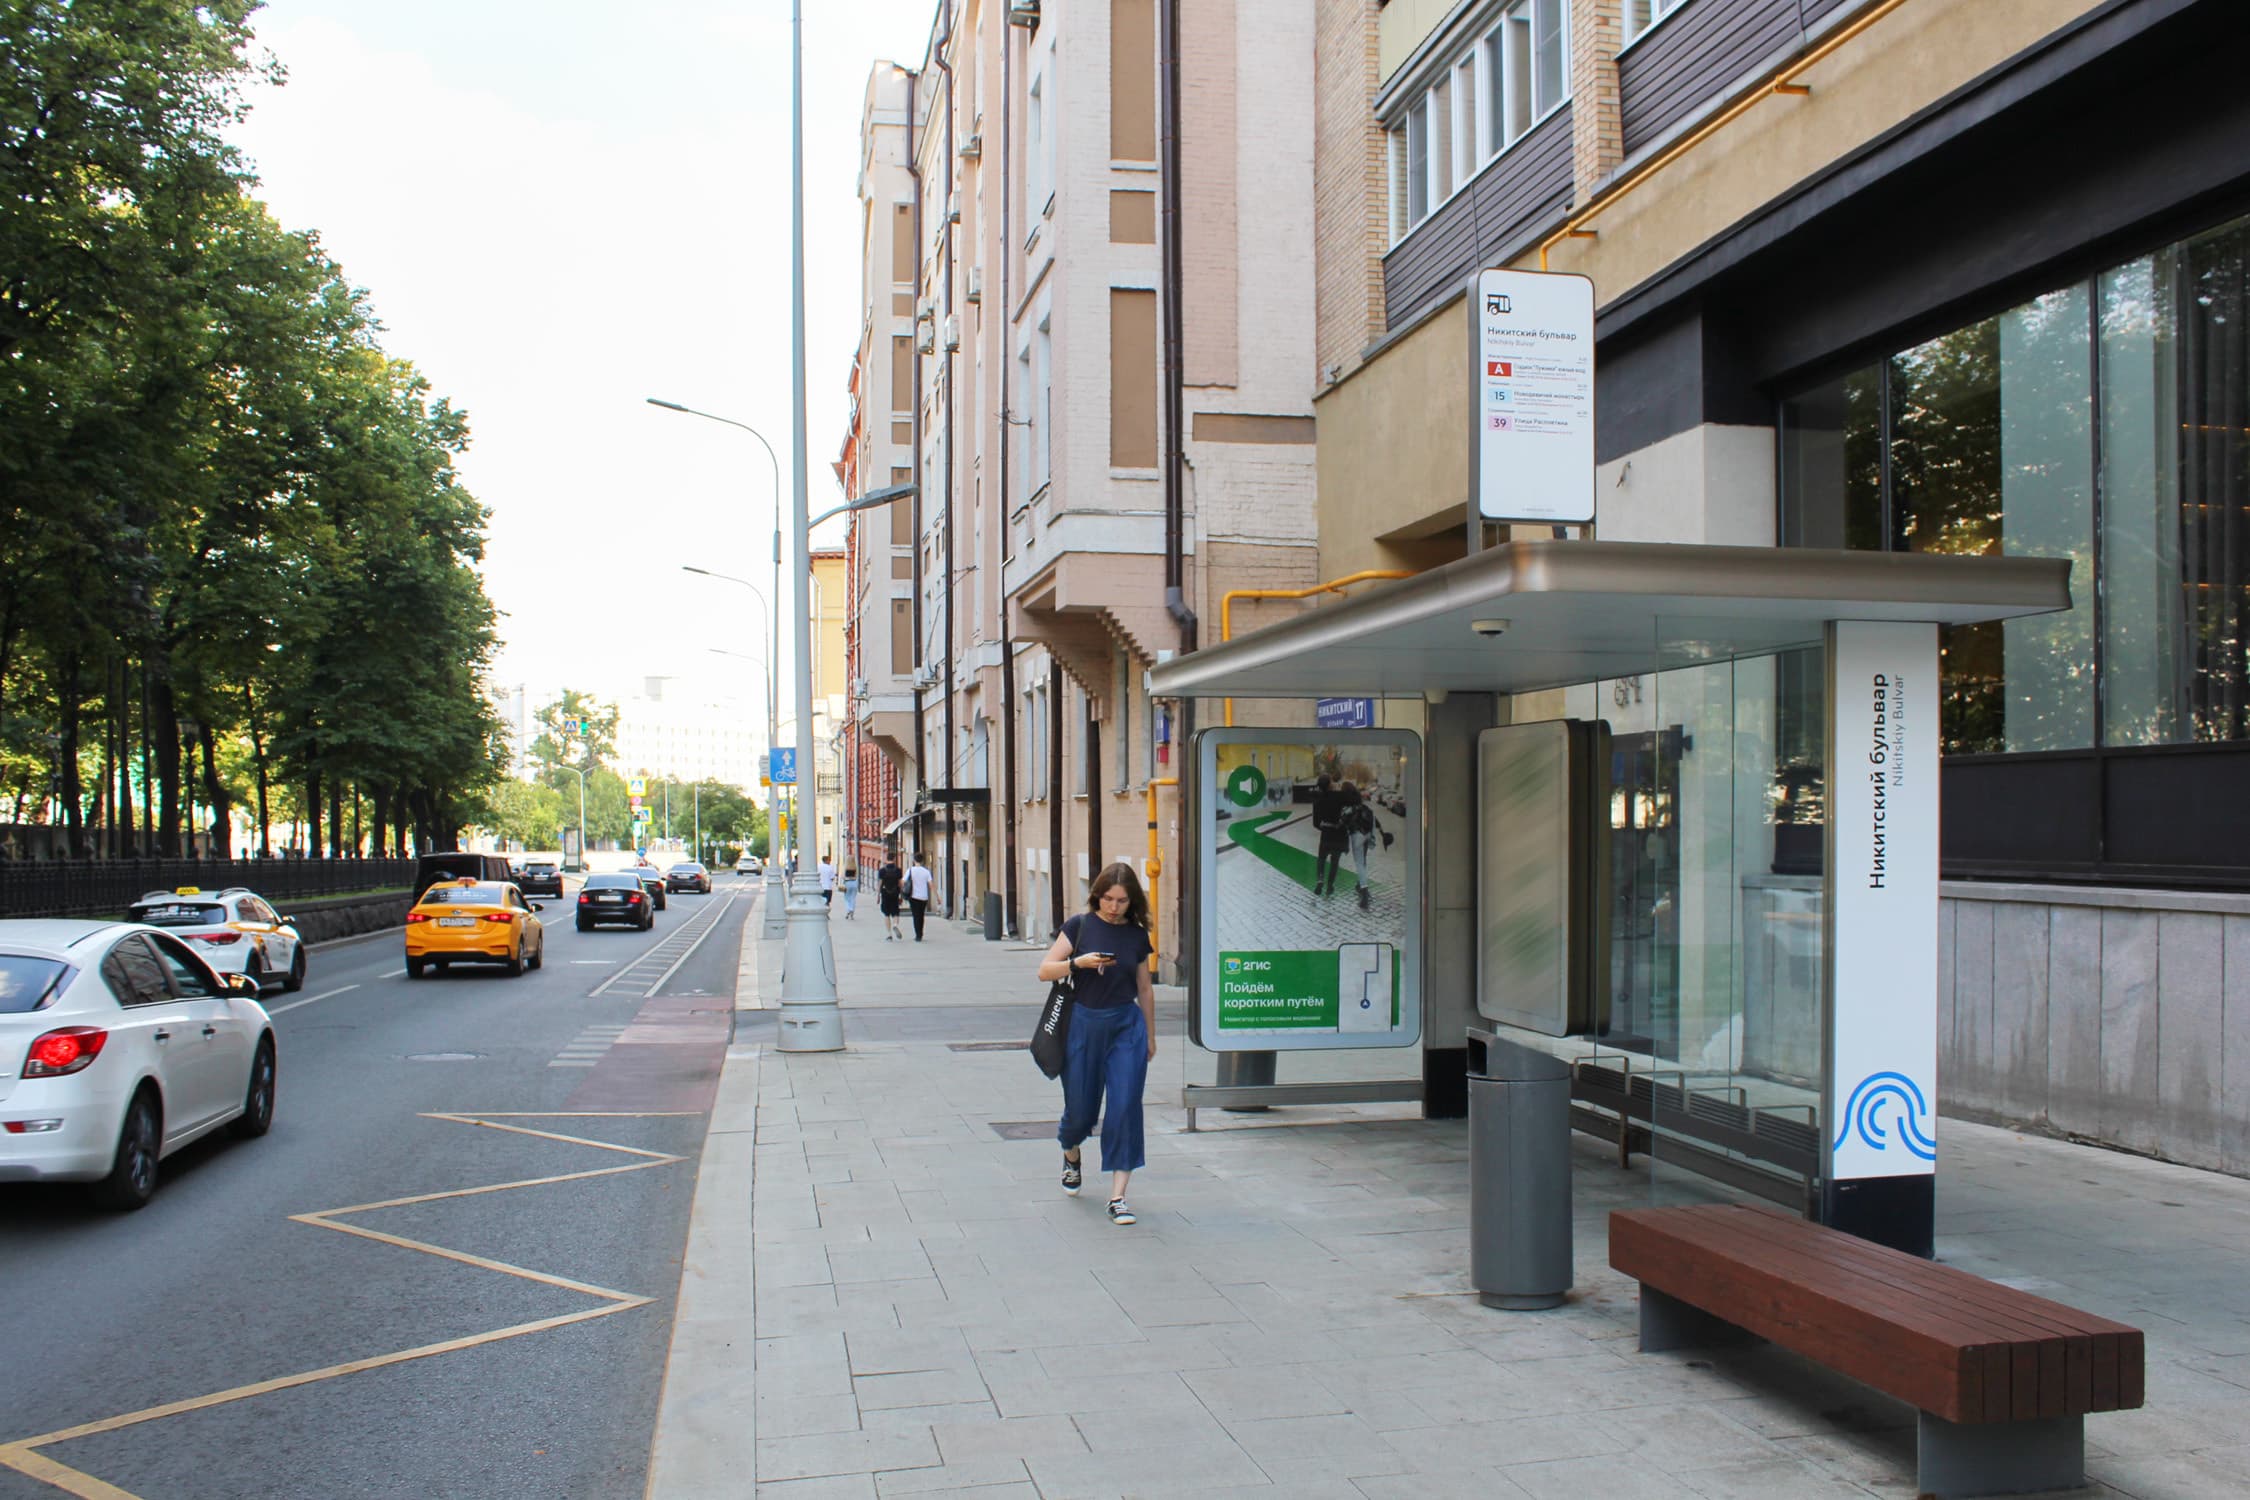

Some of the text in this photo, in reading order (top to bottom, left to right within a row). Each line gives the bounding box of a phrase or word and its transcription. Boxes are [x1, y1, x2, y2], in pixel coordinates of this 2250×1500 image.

[1487, 326, 1577, 341] Никитский бульвар
[1495, 391, 1505, 401] 15
[1494, 418, 1507, 428] 39
[1355, 701, 1364, 720] 17
[1893, 674, 1907, 787] Nikitskiy Bulvar
[1869, 673, 1889, 889] Никитский бульвар
[1243, 961, 1271, 971] 2ГИС
[1224, 982, 1274, 994] Пойдём
[1224, 995, 1325, 1010] коротким путём
